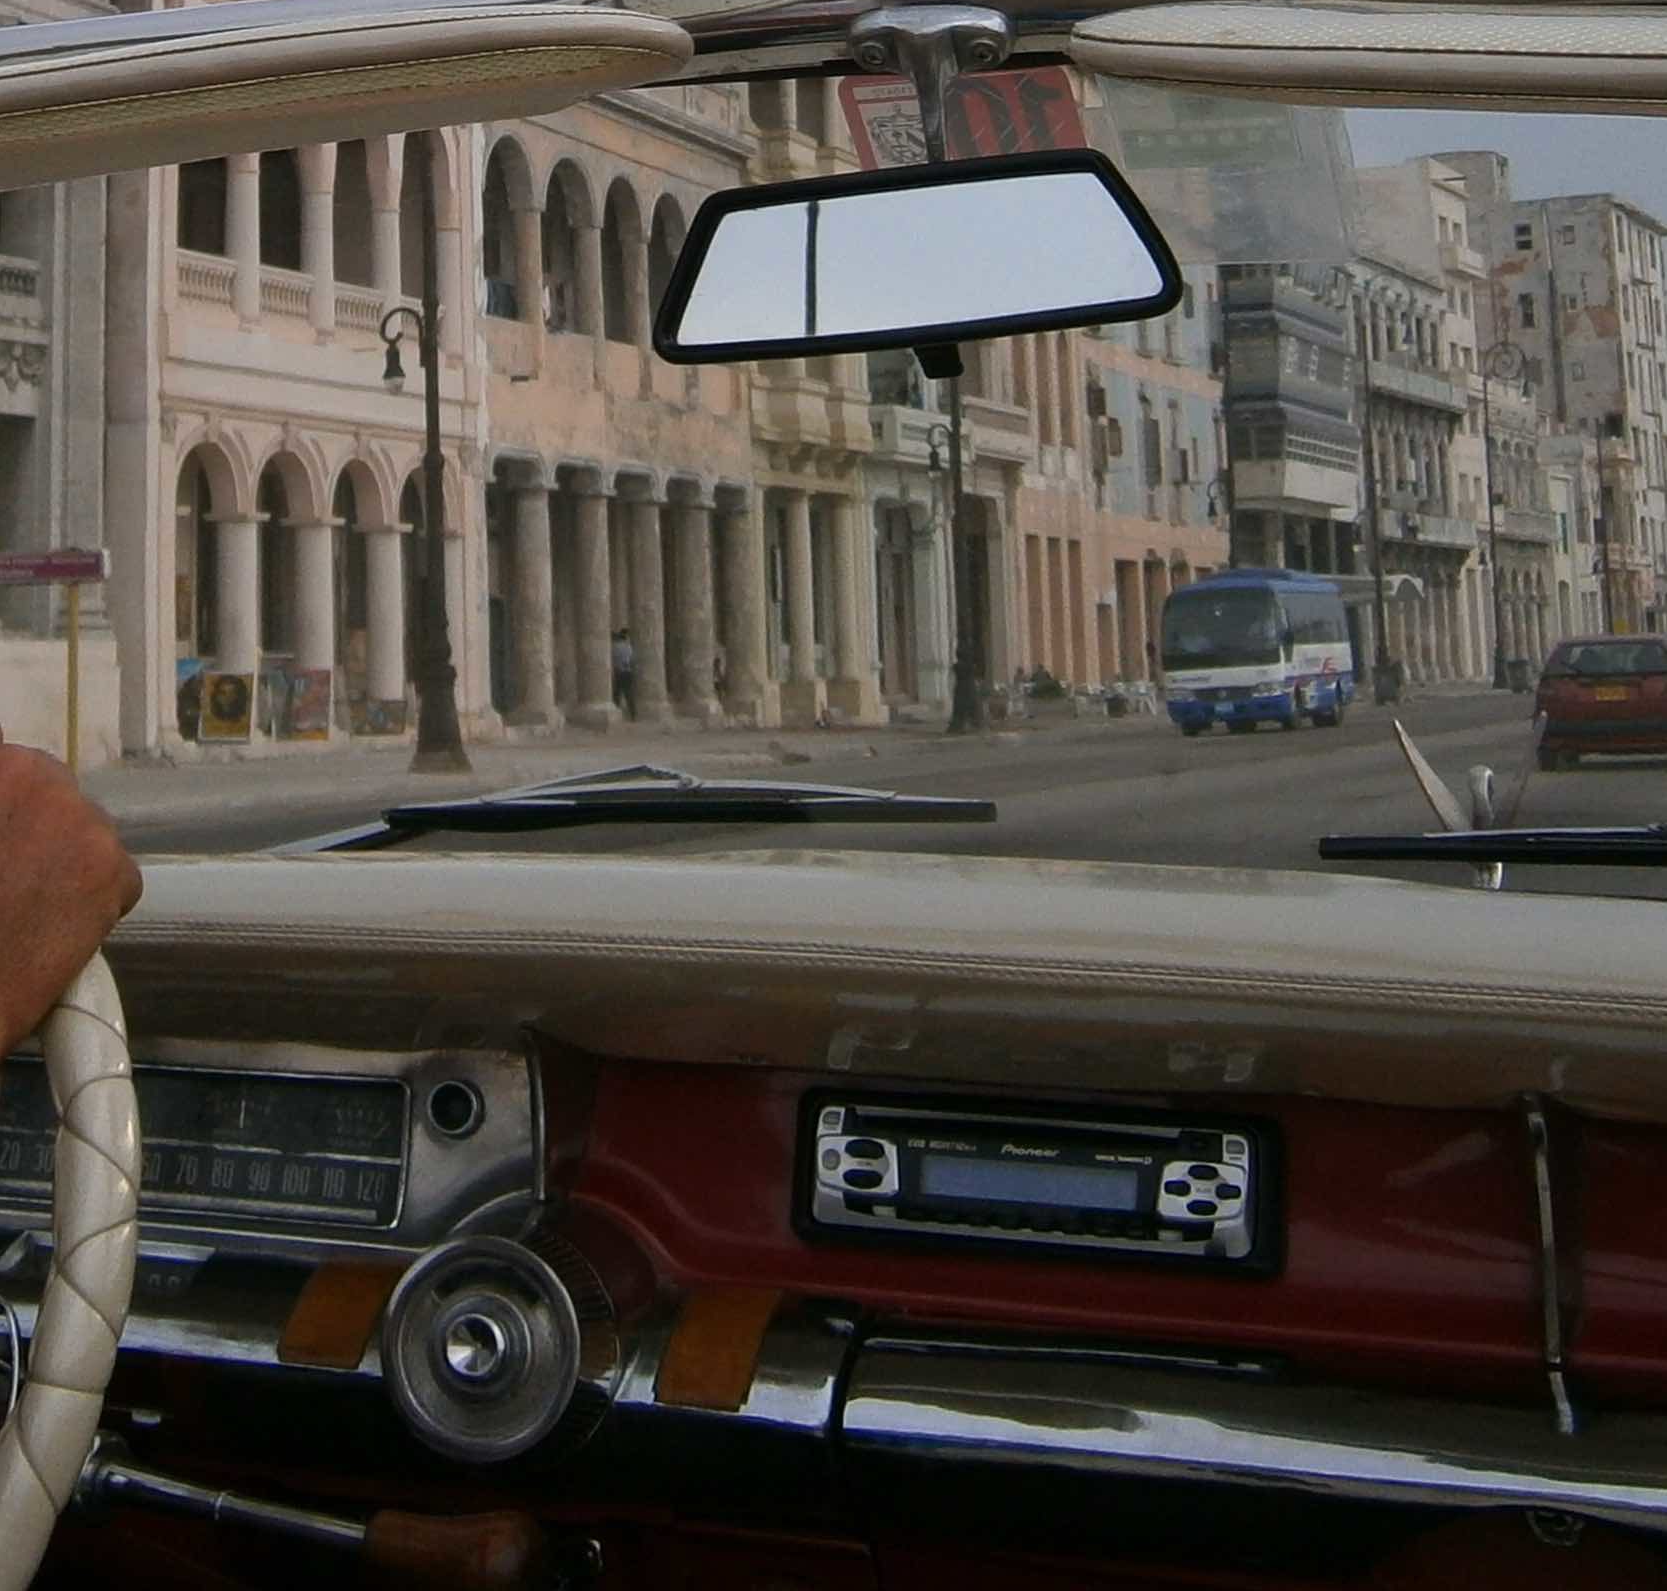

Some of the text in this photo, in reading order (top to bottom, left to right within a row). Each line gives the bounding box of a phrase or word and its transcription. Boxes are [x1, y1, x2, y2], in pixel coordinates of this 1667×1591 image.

[1001, 1143, 1060, 1158] Pioneer
[175, 1155, 199, 1185] 70
[211, 1158, 235, 1190] 80
[246, 1160, 271, 1192] 90
[282, 1163, 312, 1195] 100
[322, 1167, 347, 1200] 110
[357, 1171, 387, 1204] 120
